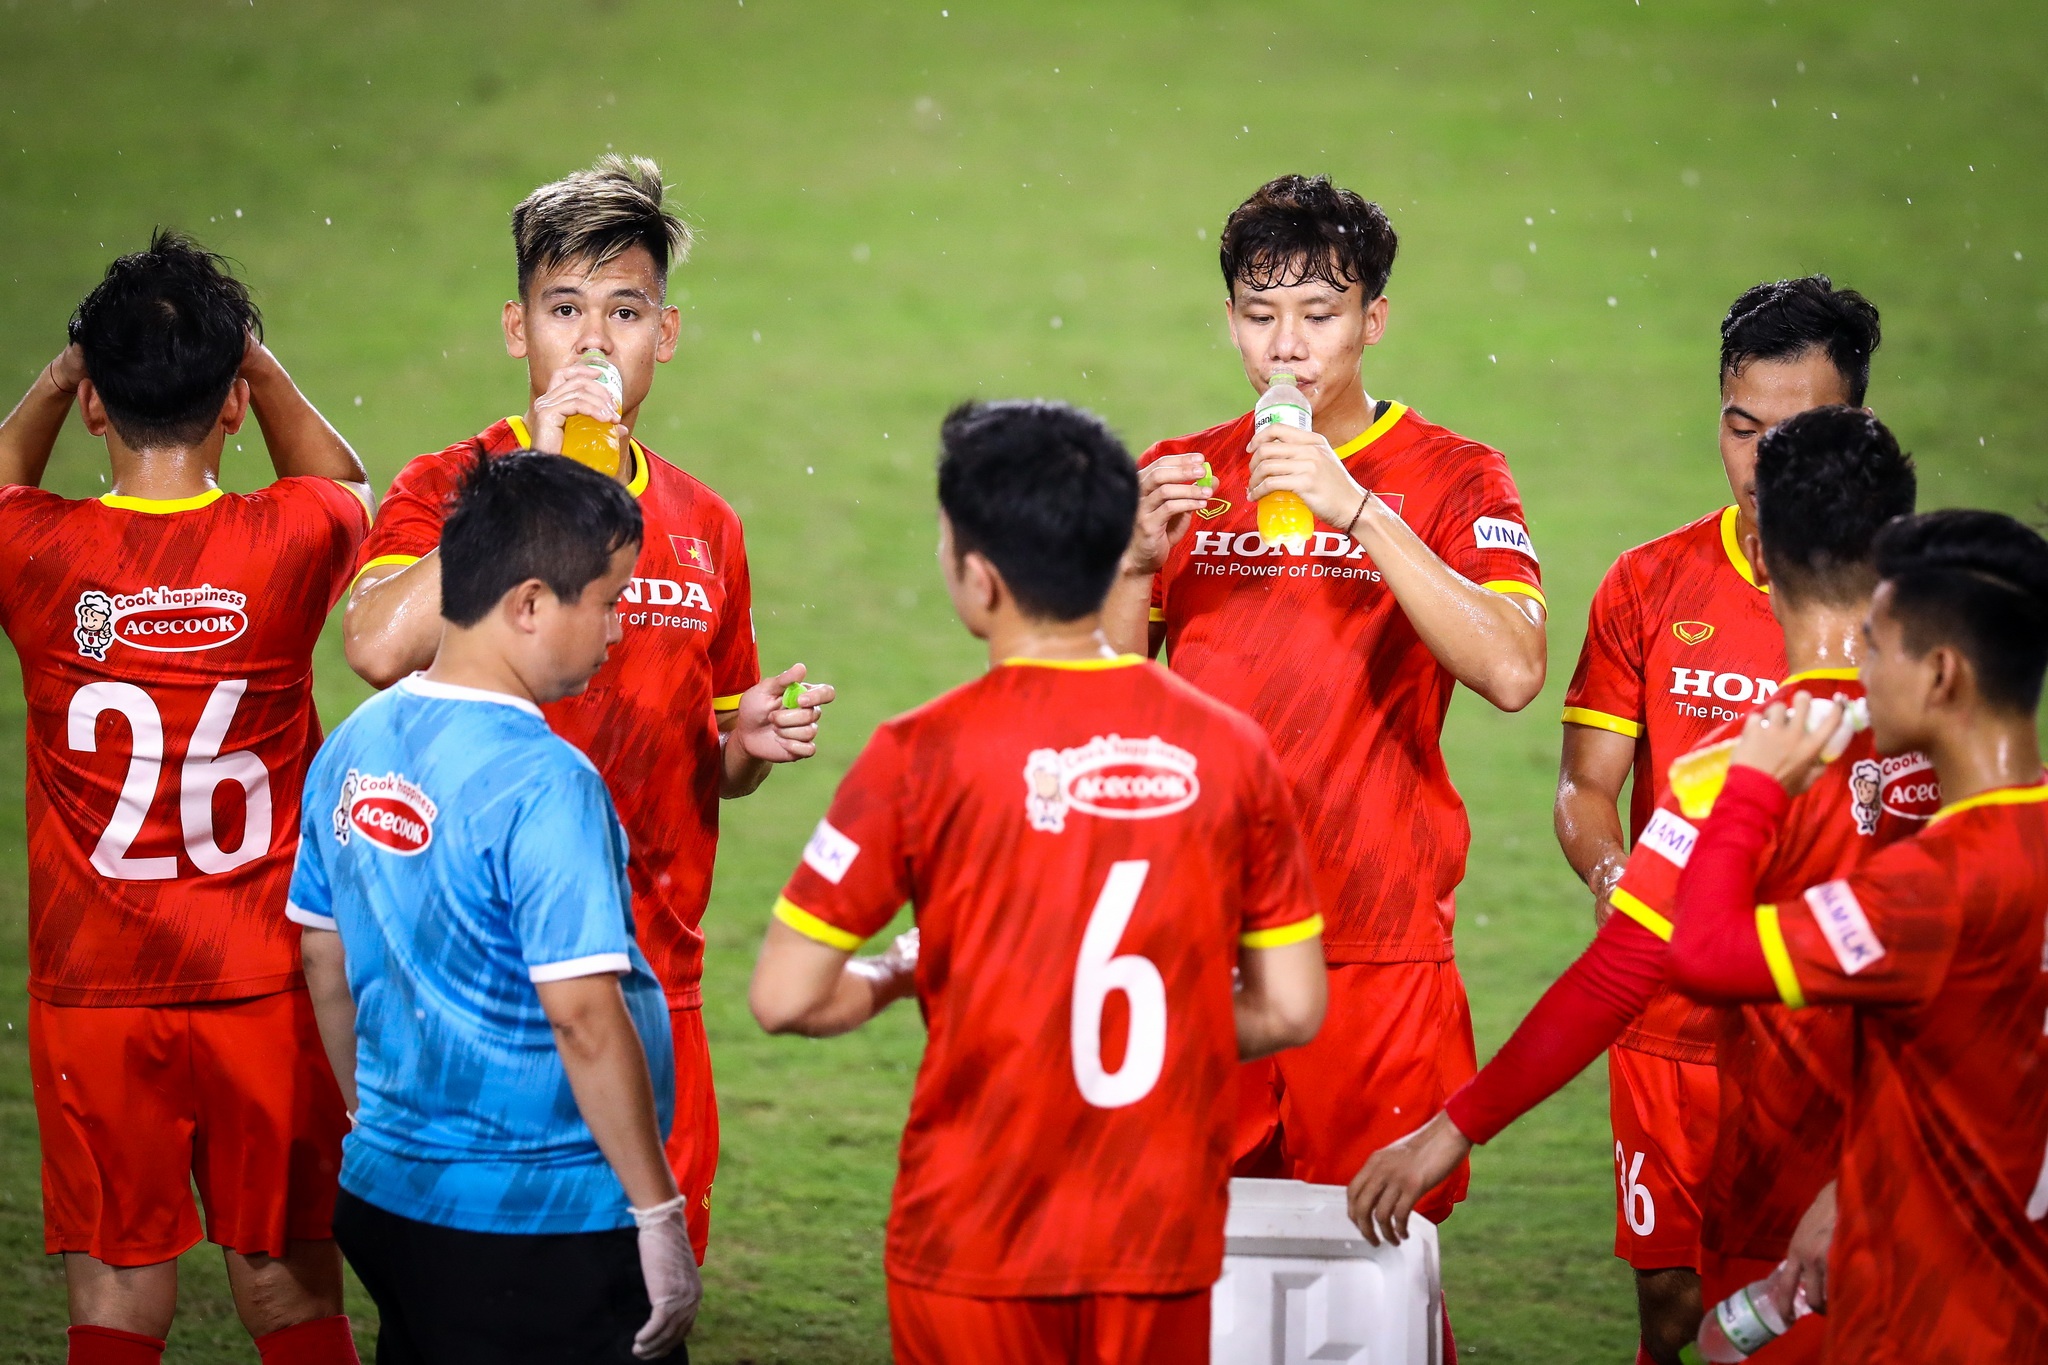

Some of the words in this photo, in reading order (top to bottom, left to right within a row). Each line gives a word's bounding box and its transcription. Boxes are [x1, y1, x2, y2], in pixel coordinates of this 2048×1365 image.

[1195, 562, 1226, 576] The
[1229, 562, 1286, 577] Power
[1288, 564, 1308, 577] of
[1312, 564, 1382, 582] Dreams
[114, 590, 157, 610] Cook
[162, 587, 244, 606] happiness
[629, 611, 647, 626] of
[652, 612, 708, 632] Dreams
[1675, 701, 1708, 719] The
[1882, 752, 1919, 776] Cook
[67, 678, 273, 881] 26
[360, 776, 394, 792] Cook
[397, 778, 435, 819] happiness
[1070, 859, 1168, 1110] 6
[1615, 1139, 1656, 1237] 36
